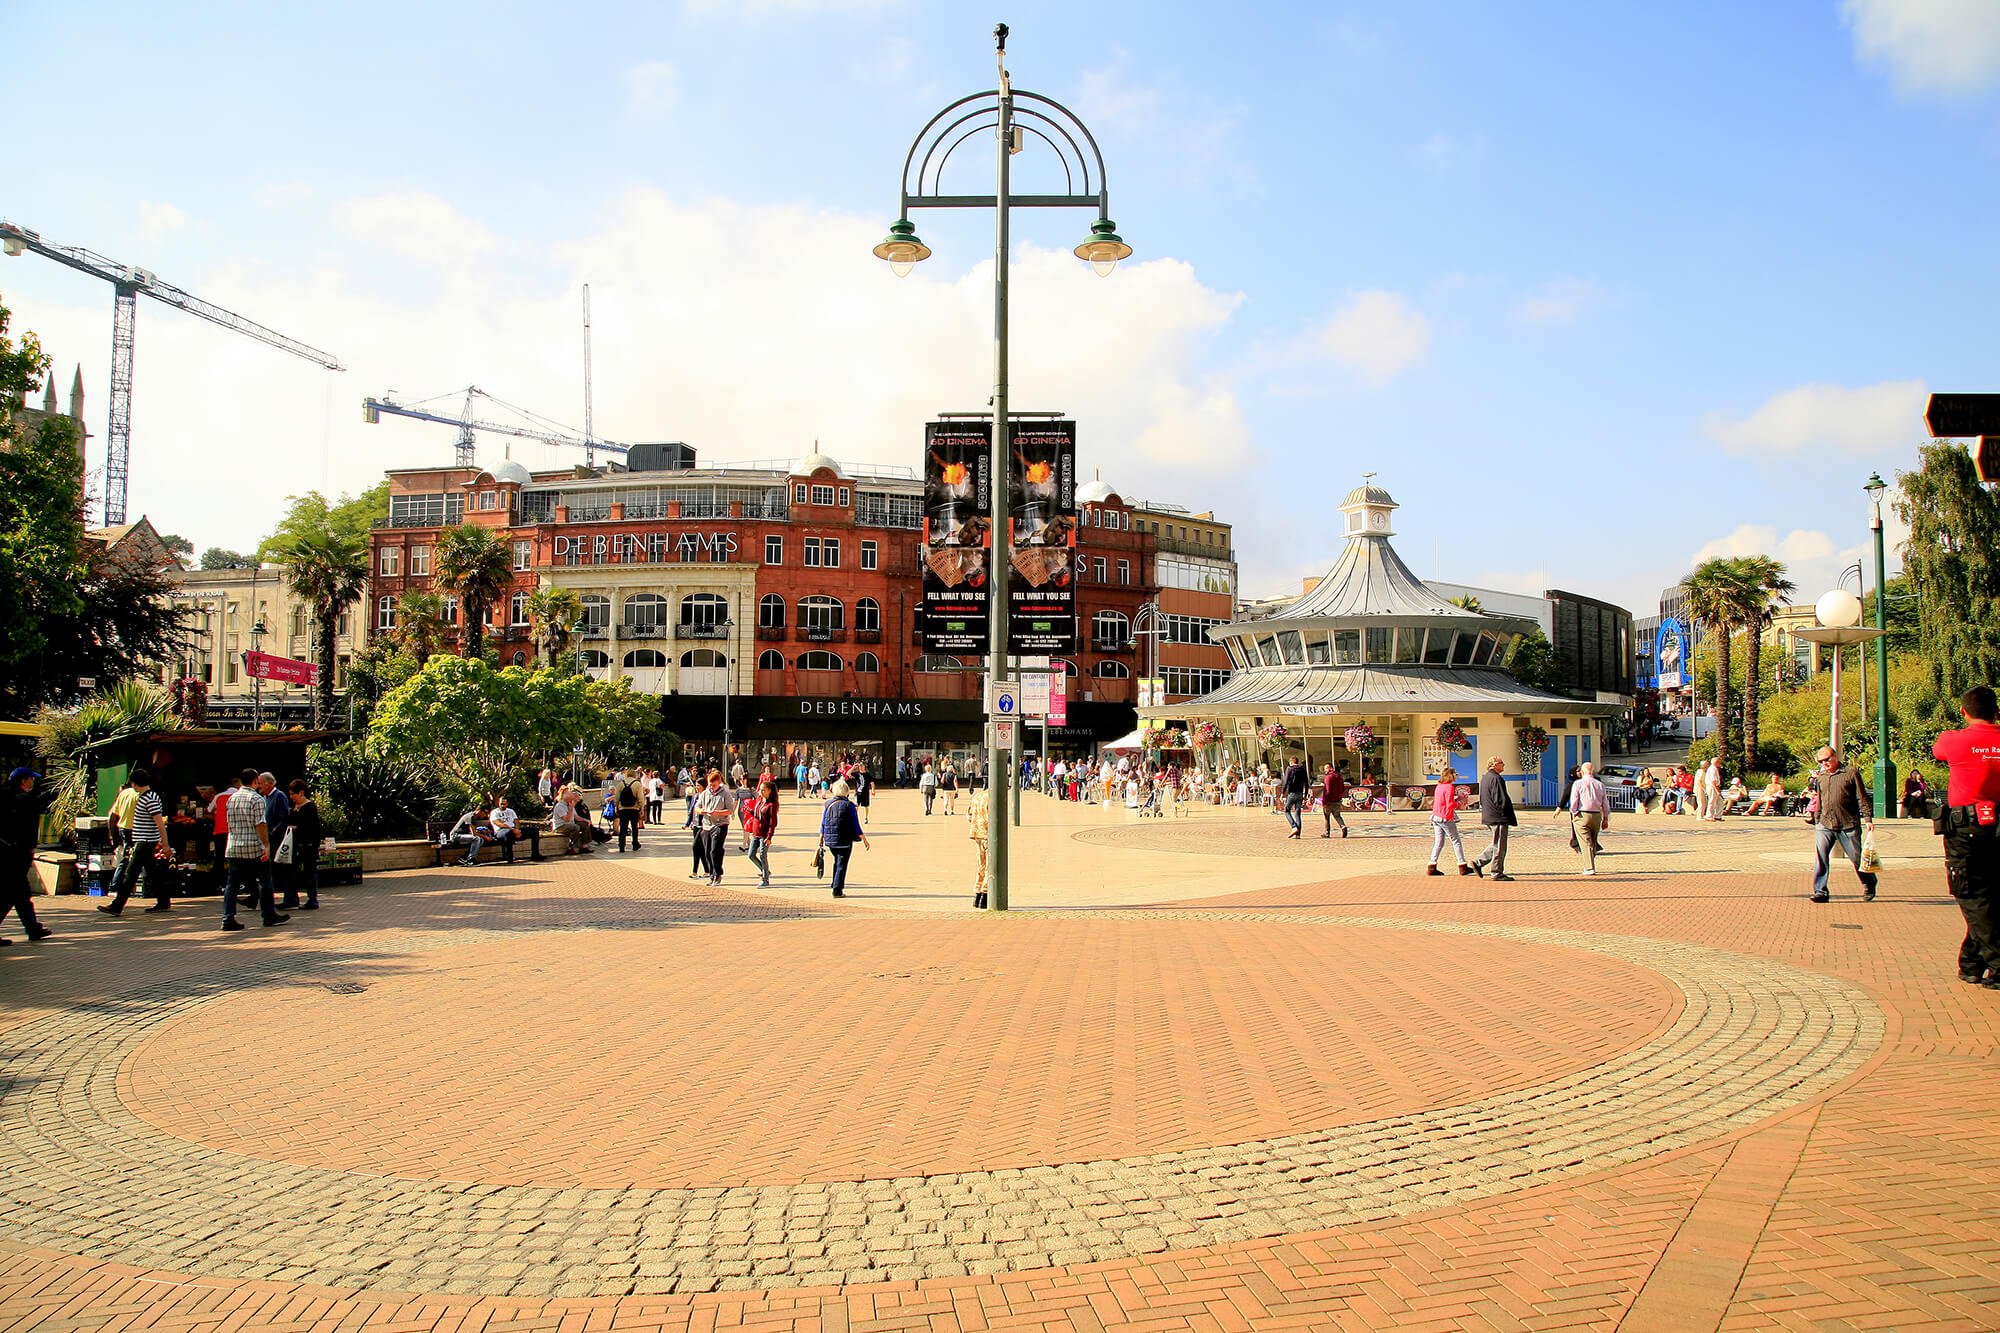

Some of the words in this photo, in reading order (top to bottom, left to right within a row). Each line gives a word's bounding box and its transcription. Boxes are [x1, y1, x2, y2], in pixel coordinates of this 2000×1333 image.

[930, 438, 945, 446] 6D
[947, 438, 987, 446] CINEMA
[1030, 436, 1071, 445] CINEMA
[554, 532, 738, 556] DEBENHAMS
[927, 592, 940, 600] FELL
[941, 592, 959, 600] WHAT
[960, 592, 974, 600] YOU
[974, 592, 986, 600] SEE
[1012, 592, 1025, 600] FELL
[1026, 592, 1044, 600] WHAT
[1045, 592, 1058, 600] YOU
[1059, 592, 1071, 600] SEE
[801, 701, 922, 716] DEBENHAMS
[1300, 705, 1335, 714] CREAM
[250, 708, 277, 719] Suare
[1971, 746, 1989, 754] Town
